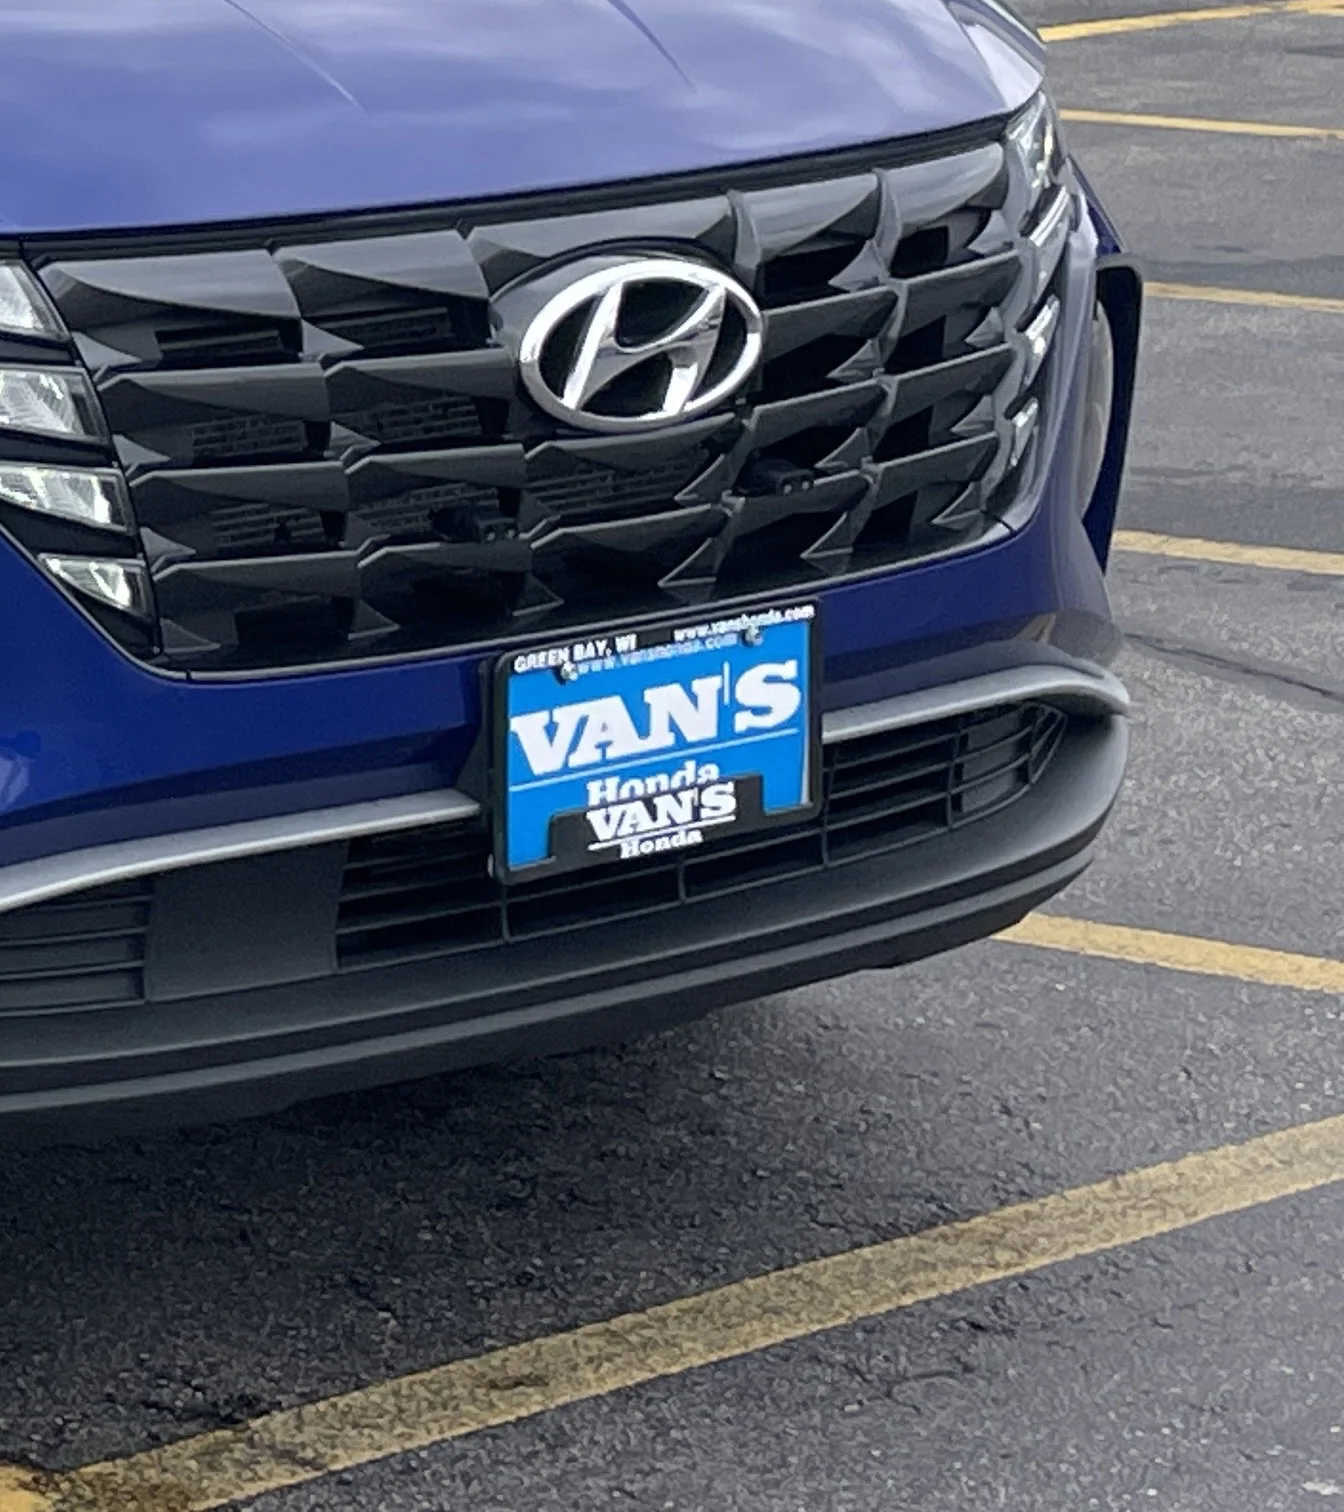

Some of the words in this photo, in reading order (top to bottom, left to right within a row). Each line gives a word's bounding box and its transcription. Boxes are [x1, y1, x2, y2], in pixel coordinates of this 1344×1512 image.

[514, 647, 570, 673] GREEN
[573, 639, 612, 661] BAY,
[615, 633, 637, 653] WI
[512, 659, 802, 775] VAN'S
[586, 760, 720, 808] Honda
[586, 782, 737, 841] VAN'S
[620, 830, 704, 859] Honda
